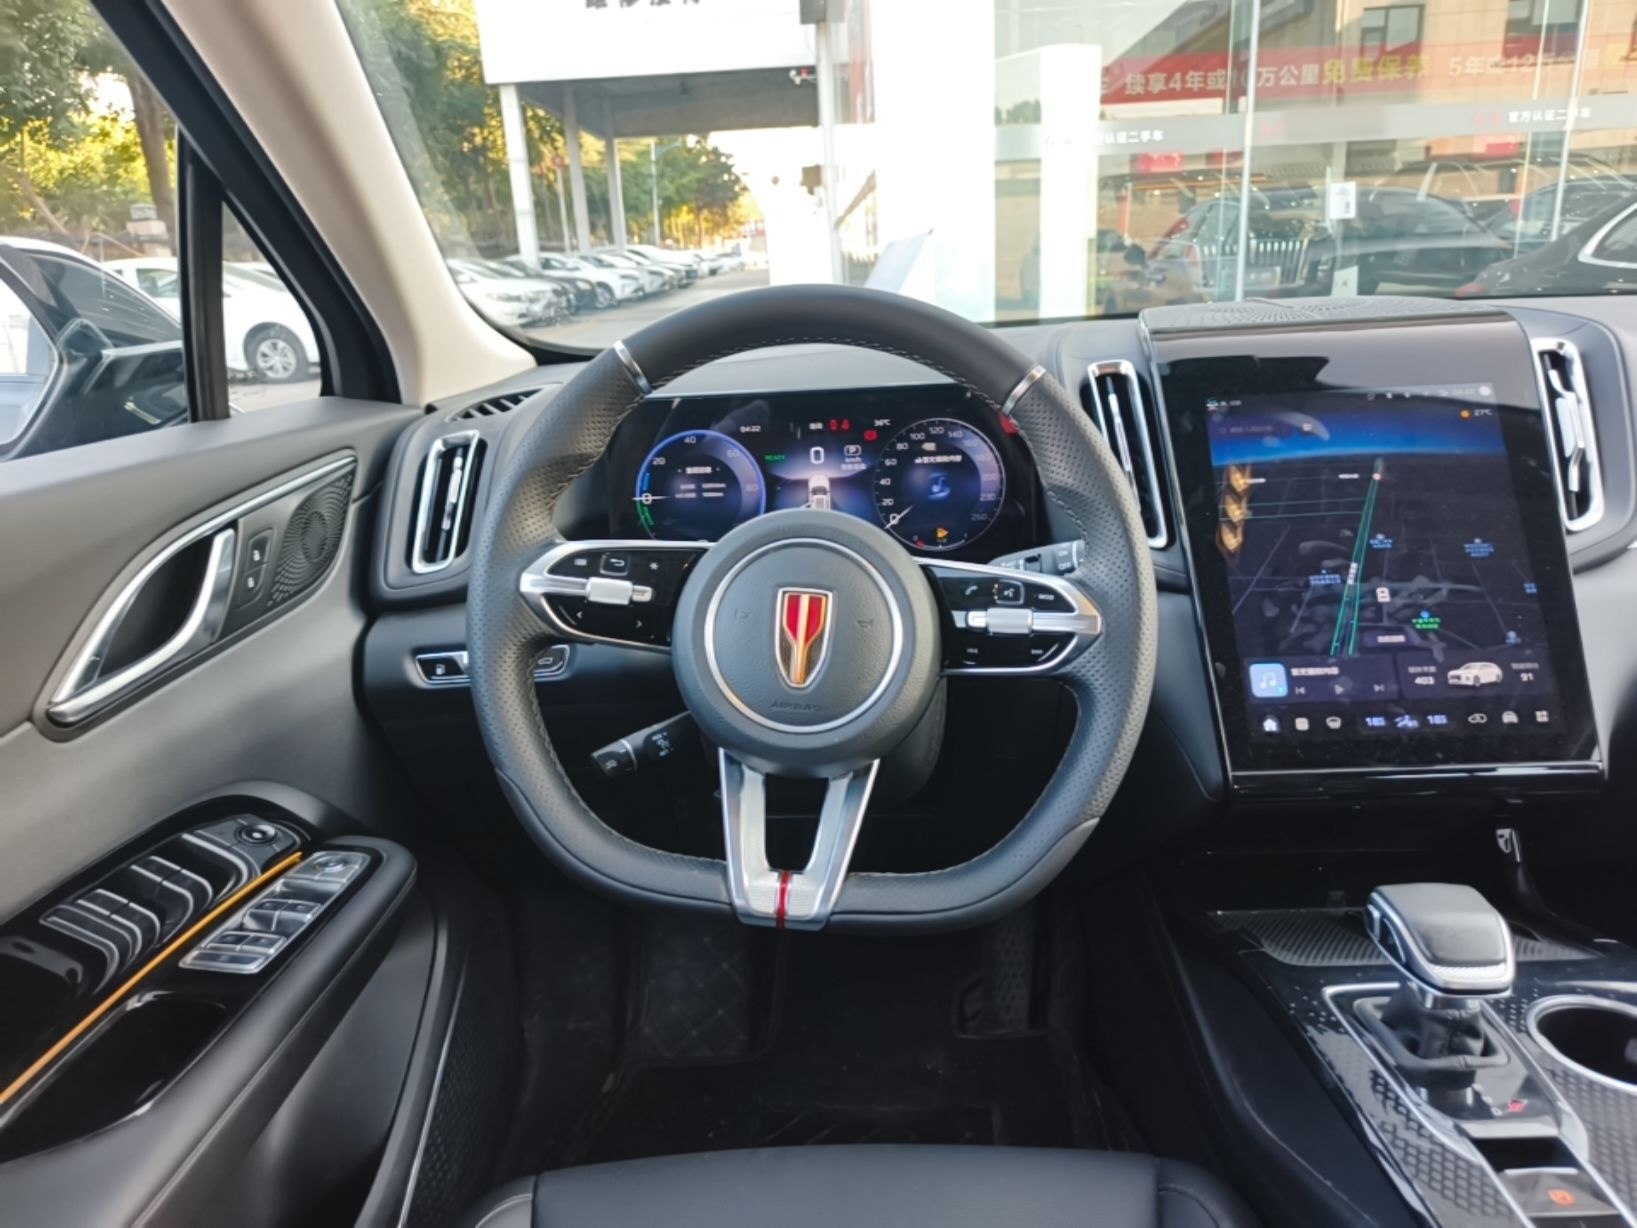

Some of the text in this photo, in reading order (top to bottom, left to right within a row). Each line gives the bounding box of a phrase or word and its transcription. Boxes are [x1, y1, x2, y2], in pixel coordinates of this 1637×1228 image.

[1509, 108, 1592, 124] 官方认证二车
[929, 426, 945, 434] 120
[684, 435, 697, 443] 40
[910, 432, 926, 440] 100
[896, 442, 909, 450] 80
[809, 446, 824, 465] 0
[652, 457, 666, 466] 20
[885, 458, 897, 467] 60
[879, 477, 891, 486] 40
[641, 492, 652, 504] 0
[881, 498, 895, 507] 20
[889, 513, 899, 525] 0
[1520, 672, 1534, 682] 91
